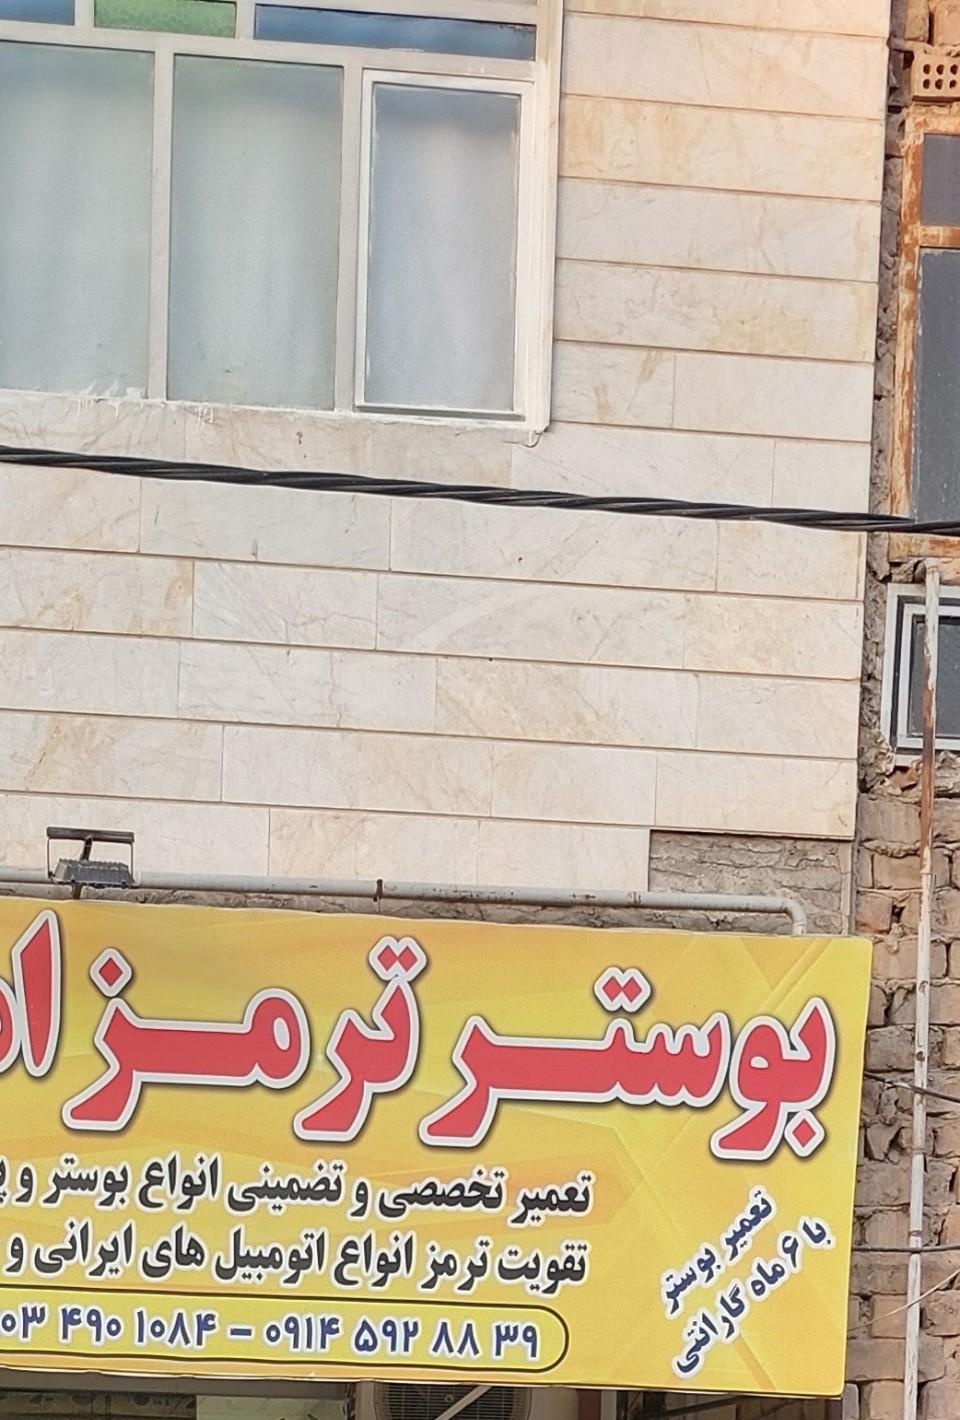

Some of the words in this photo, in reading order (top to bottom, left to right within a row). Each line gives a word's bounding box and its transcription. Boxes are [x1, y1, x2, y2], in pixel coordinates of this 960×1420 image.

[62, 936, 427, 1142] ترمز
[419, 967, 837, 1160] بوستر
[15, 1166, 34, 1203] و
[42, 1157, 129, 1206] بوستر
[138, 1154, 220, 1210] انواع
[227, 1163, 344, 1213] تضمینی
[350, 1180, 369, 1217] و
[378, 1169, 505, 1218] تخصصی
[510, 1175, 592, 1224] تعمیر
[34, 1221, 133, 1277] ایرانی
[724, 1189, 773, 1262] تعمیر
[801, 1220, 832, 1246] با
[5, 1236, 24, 1273] و
[141, 1225, 206, 1279] های
[214, 1228, 326, 1284] اتومبیل
[333, 1233, 414, 1288] انواع
[420, 1239, 490, 1291] ترمز
[497, 1244, 588, 1295] تقویت
[781, 1235, 799, 1269] ۶
[665, 1247, 722, 1315] بوستر
[750, 1261, 786, 1297] ماه
[61, 1307, 122, 1342] ۴۹۰
[137, 1310, 218, 1346] ۱۰۸۴
[265, 1316, 340, 1351] ۰۹۱۴
[354, 1319, 419, 1353] ۵۹۲
[432, 1321, 480, 1356] ۸۸
[495, 1324, 539, 1358] ۳۹
[676, 1283, 746, 1374] گارانتی
